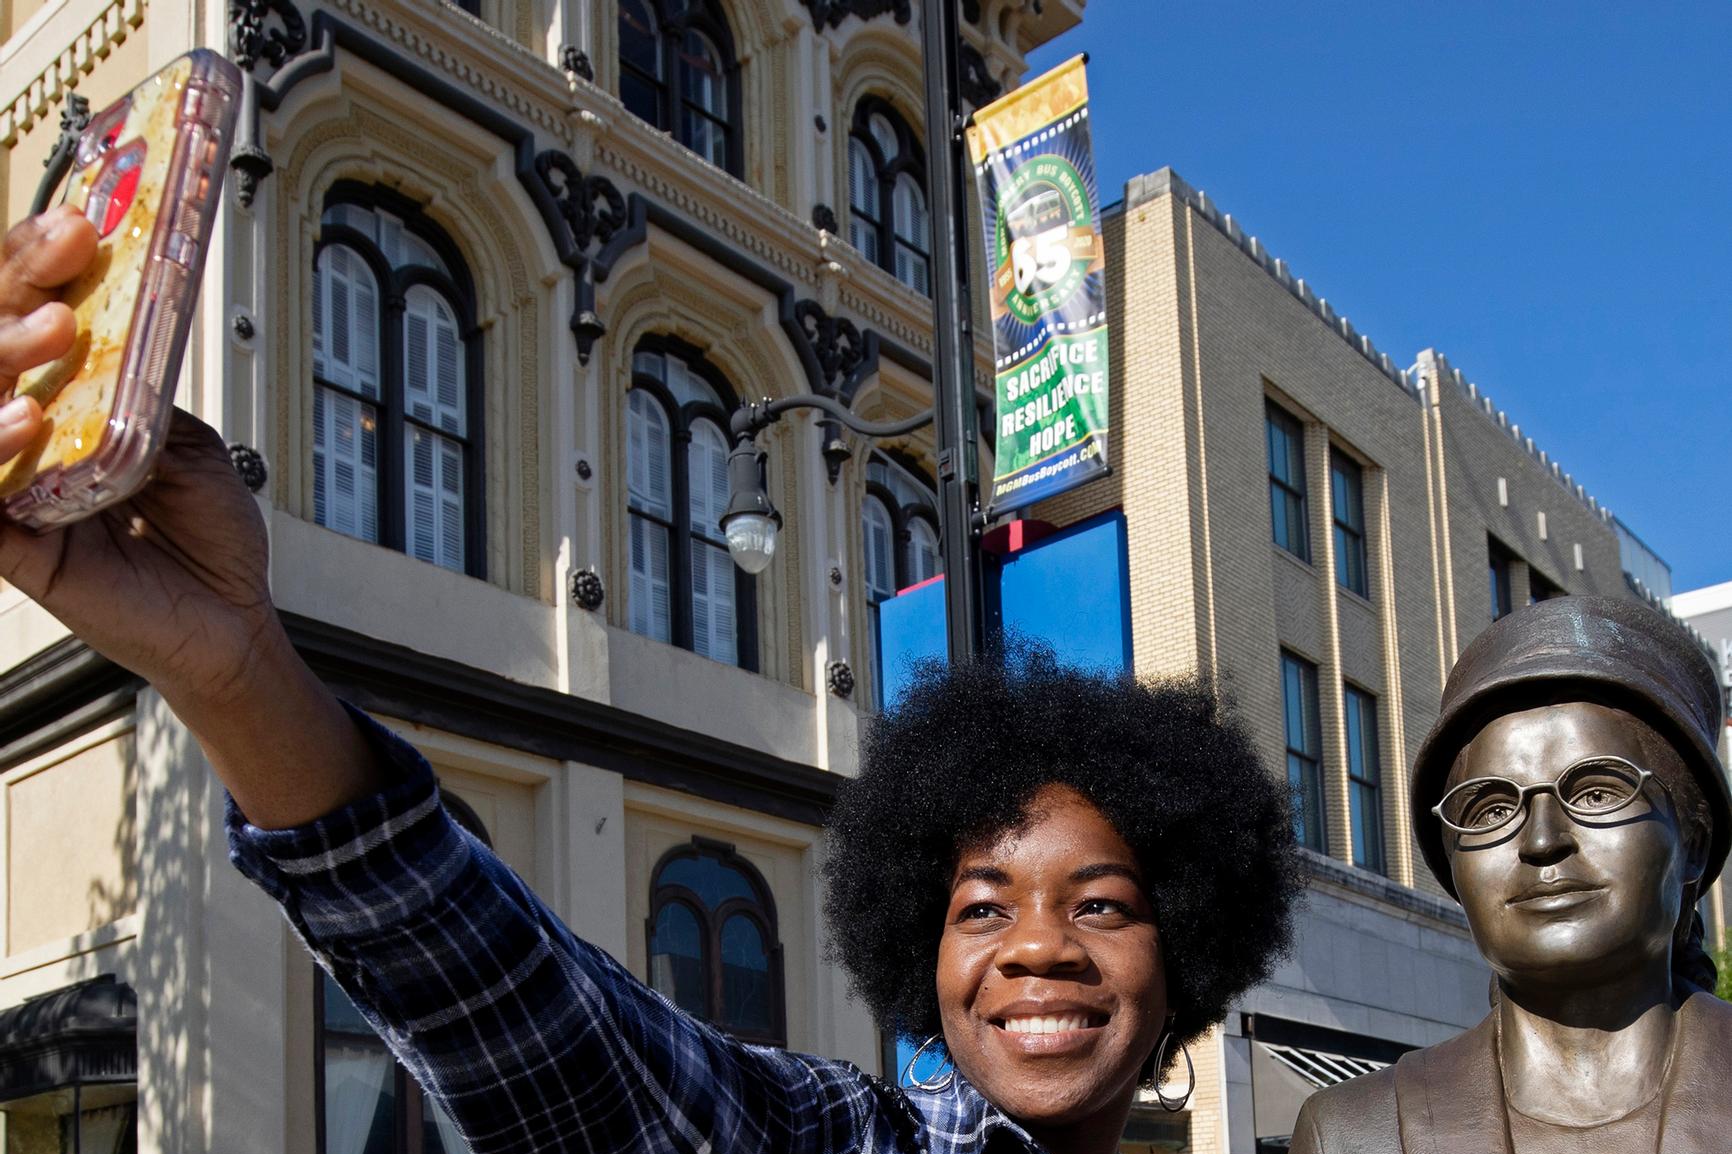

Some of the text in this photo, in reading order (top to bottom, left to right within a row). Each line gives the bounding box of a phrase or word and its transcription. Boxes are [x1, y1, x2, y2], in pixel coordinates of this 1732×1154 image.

[1036, 164, 1058, 177] BUS
[1059, 171, 1085, 220] BOYCOTT
[1007, 339, 1098, 402] SACRIFICE
[1002, 371, 1104, 437] RESILIENCE
[1030, 414, 1076, 458] HOPE
